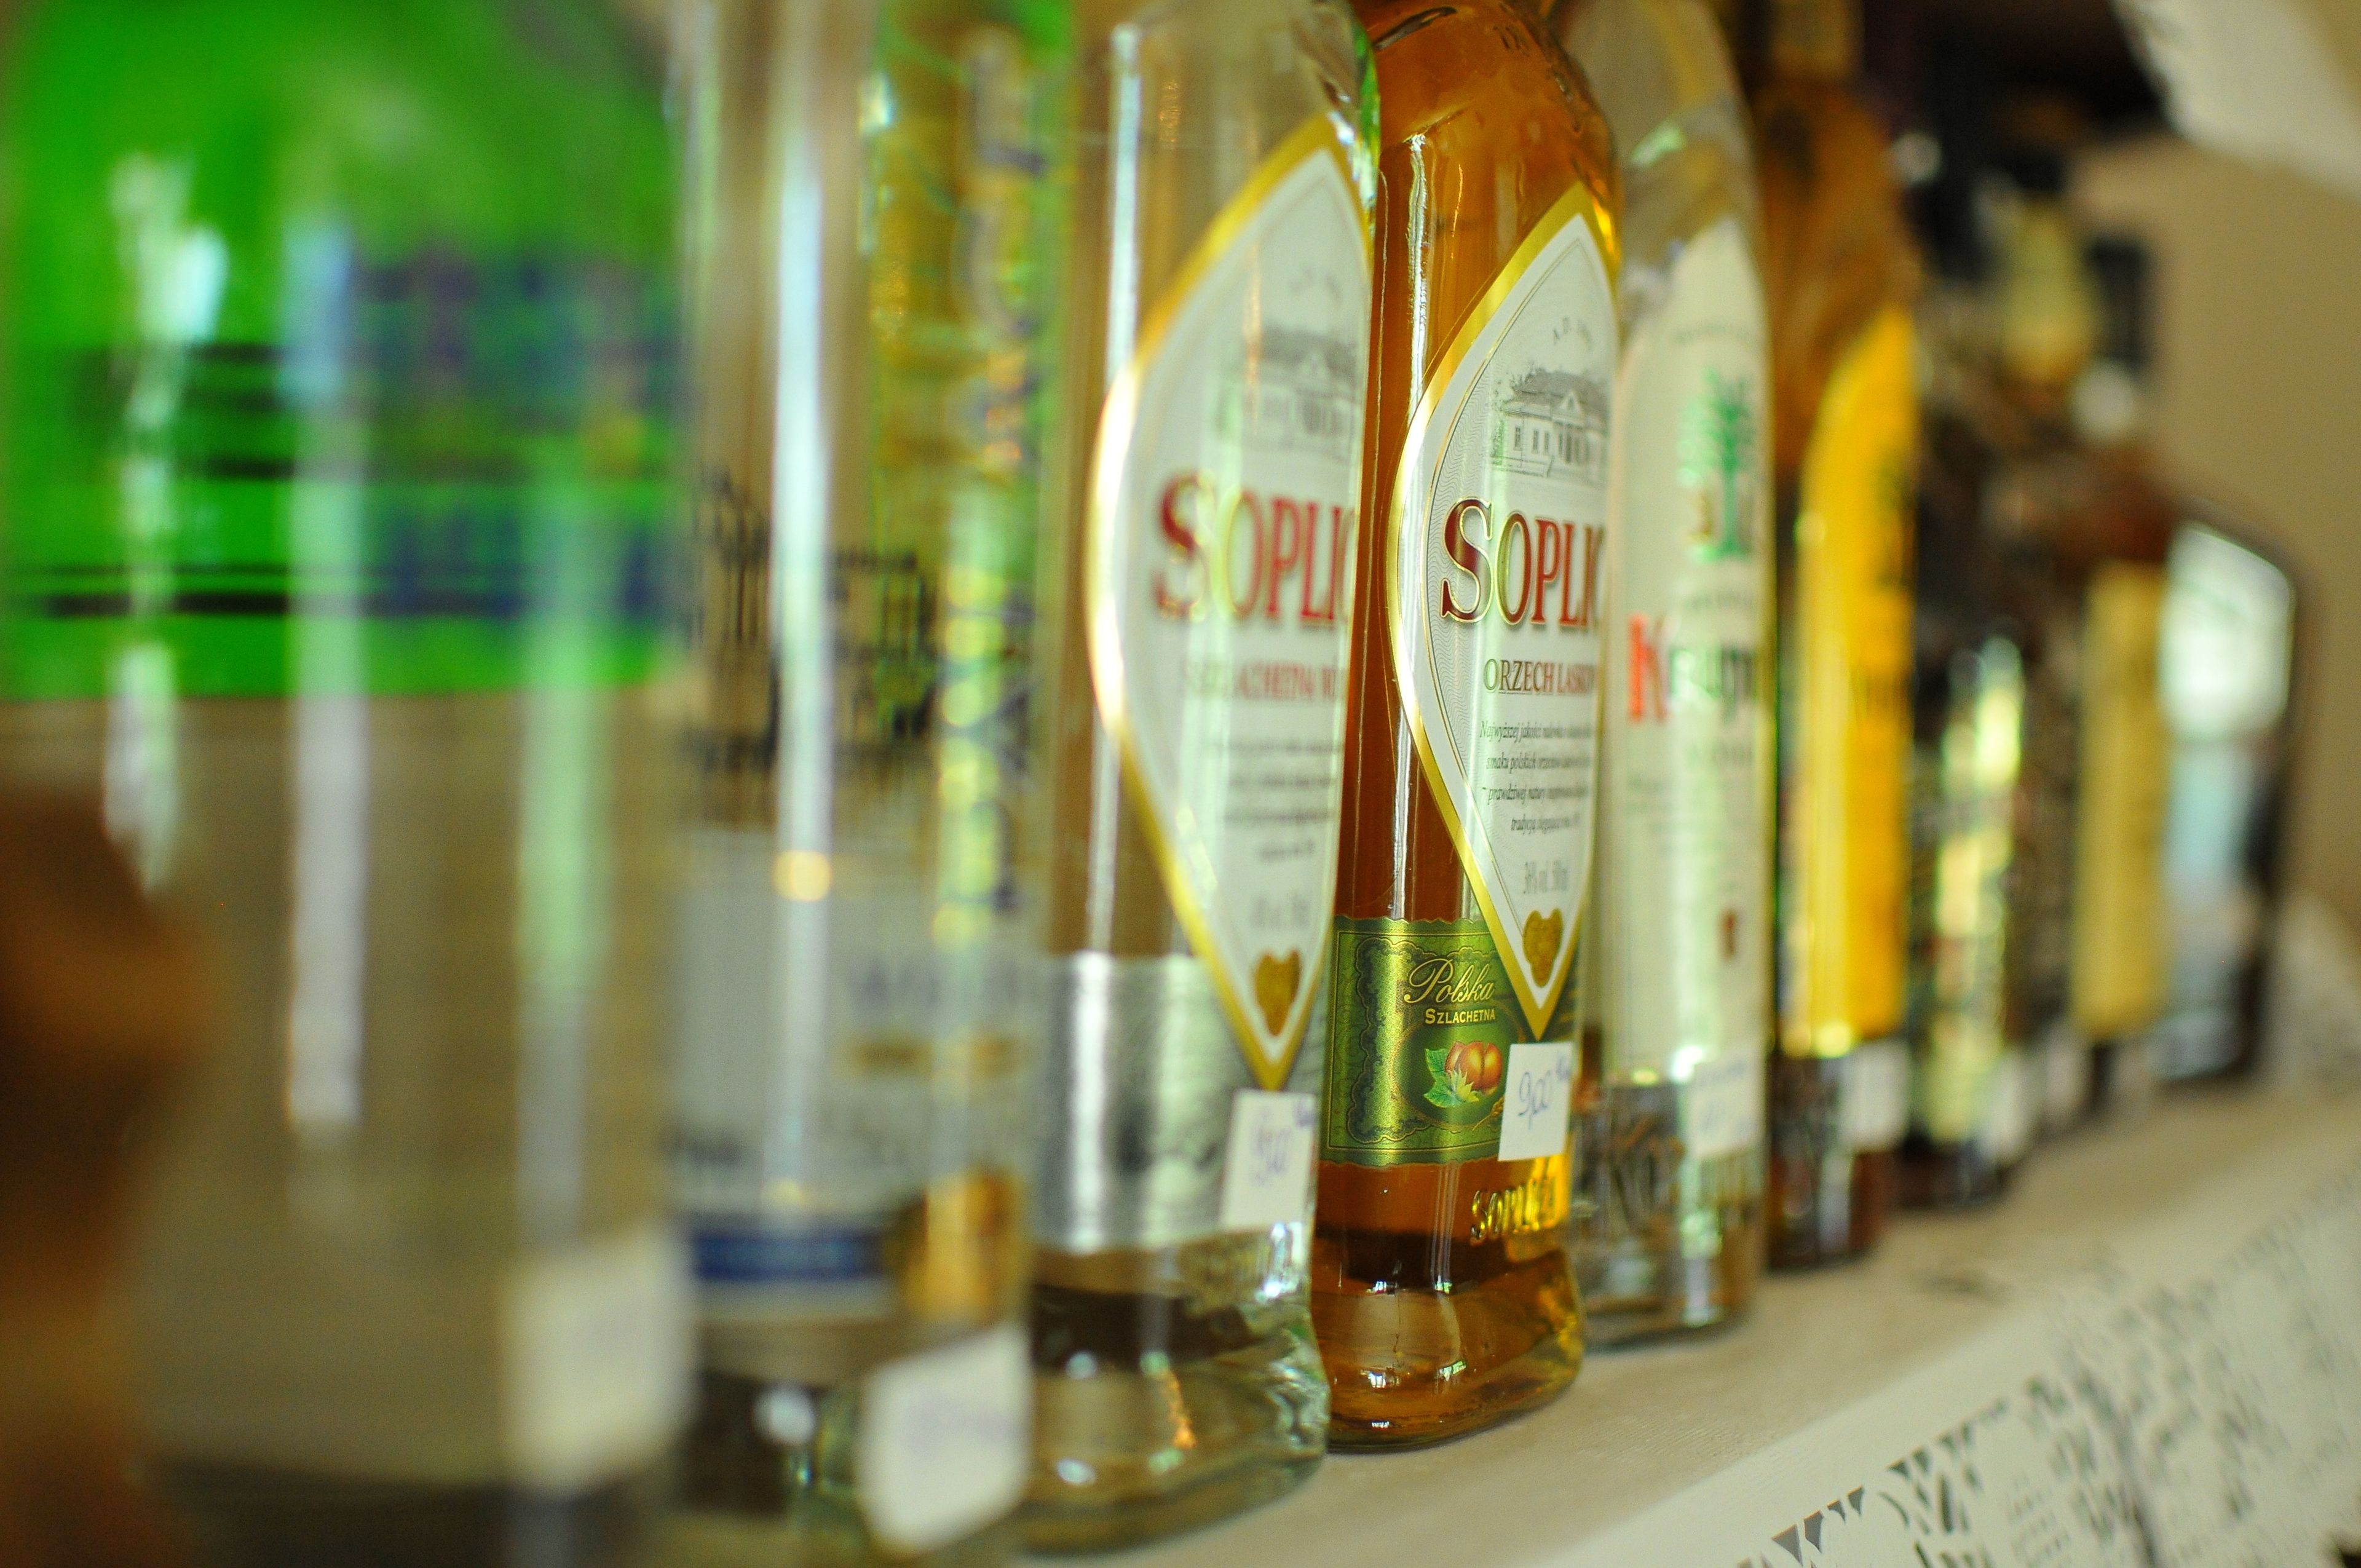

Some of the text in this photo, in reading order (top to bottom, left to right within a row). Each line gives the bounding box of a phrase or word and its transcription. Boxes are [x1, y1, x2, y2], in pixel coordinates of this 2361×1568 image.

[1484, 658, 1555, 692] ORZECH
[1404, 957, 1495, 1004] Polska
[1425, 1007, 1496, 1024] SZLACHETNA
